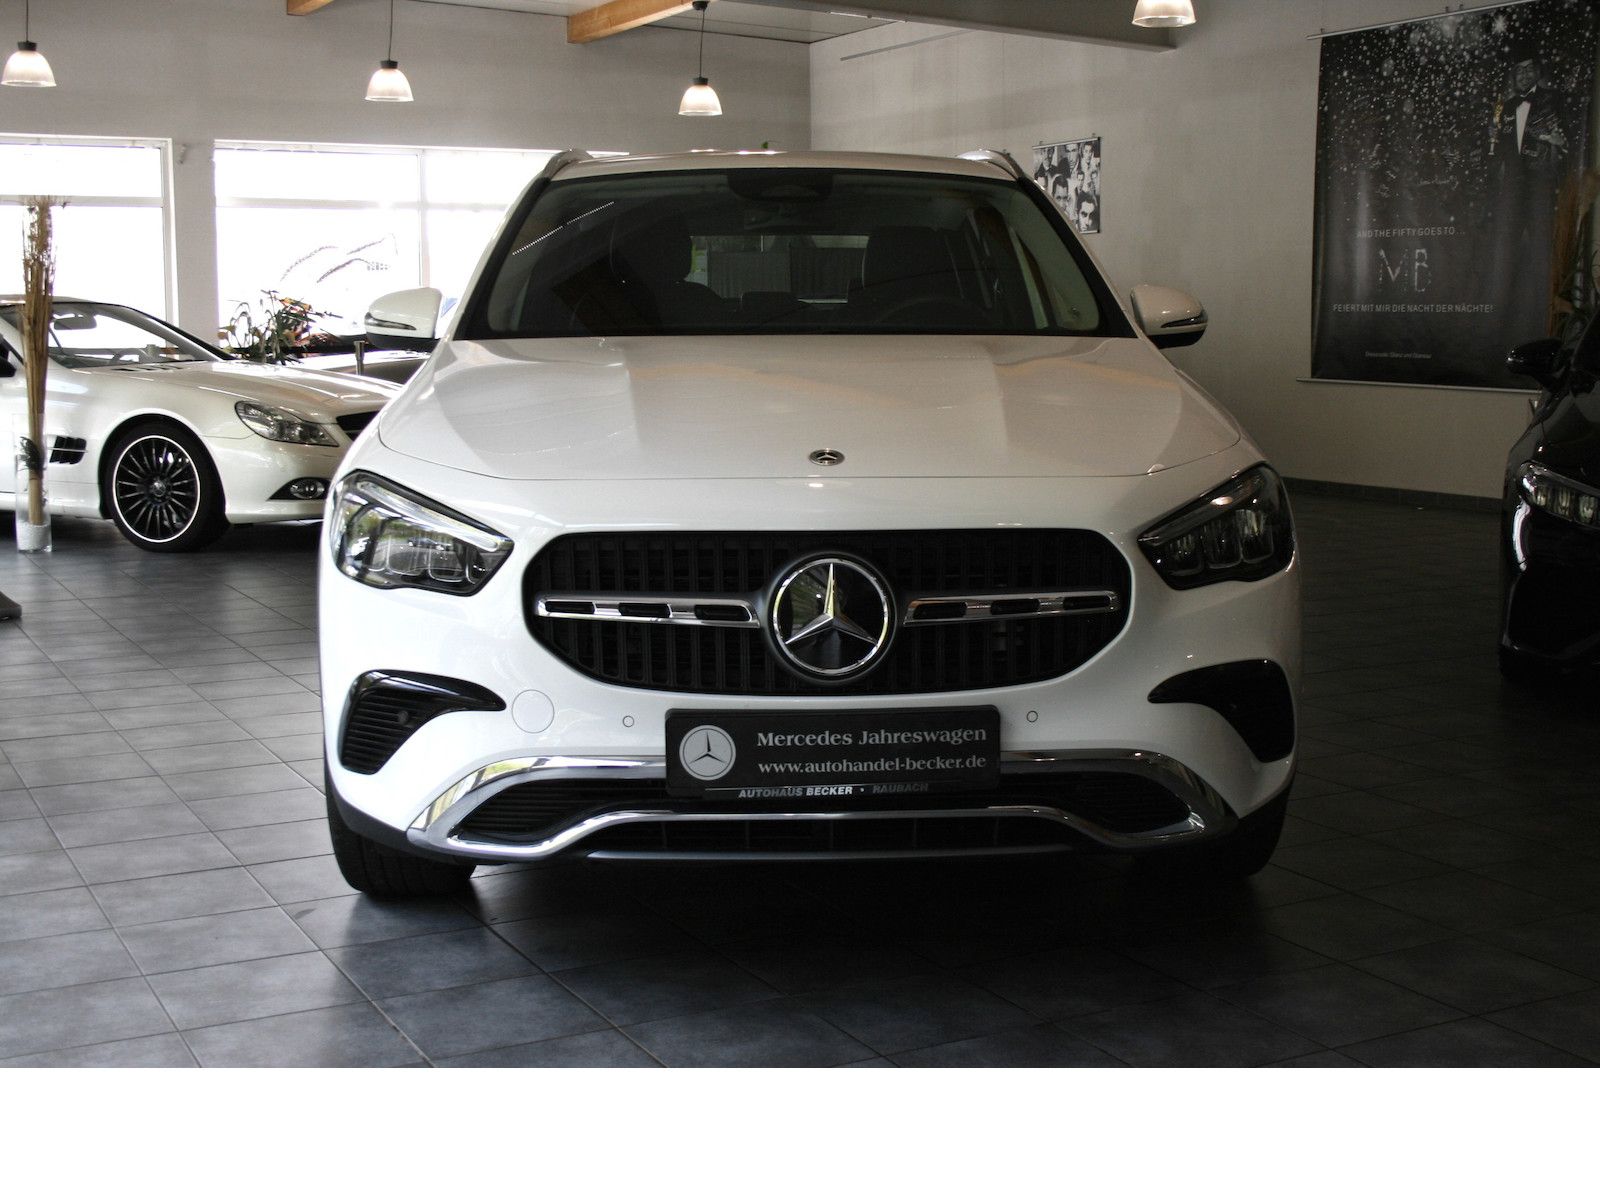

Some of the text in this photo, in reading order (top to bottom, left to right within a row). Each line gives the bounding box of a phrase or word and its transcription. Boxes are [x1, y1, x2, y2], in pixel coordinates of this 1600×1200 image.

[1356, 230, 1373, 238] AND
[1374, 229, 1391, 238] THE
[1392, 228, 1417, 237] FIFTY
[1417, 227, 1442, 236] GOES
[1332, 303, 1361, 313] FEIERT
[1361, 303, 1375, 313] MIT
[1375, 303, 1391, 313] MIR
[1392, 303, 1406, 313] DIE
[1407, 303, 1435, 313] NACHT
[1435, 303, 1454, 313] DER
[756, 728, 987, 747] Mercedes Jahreswagen
[758, 754, 987, 773] www.autohandel-becker.de
[738, 783, 929, 798] AUTOHAUS BECKER RAUBACH
